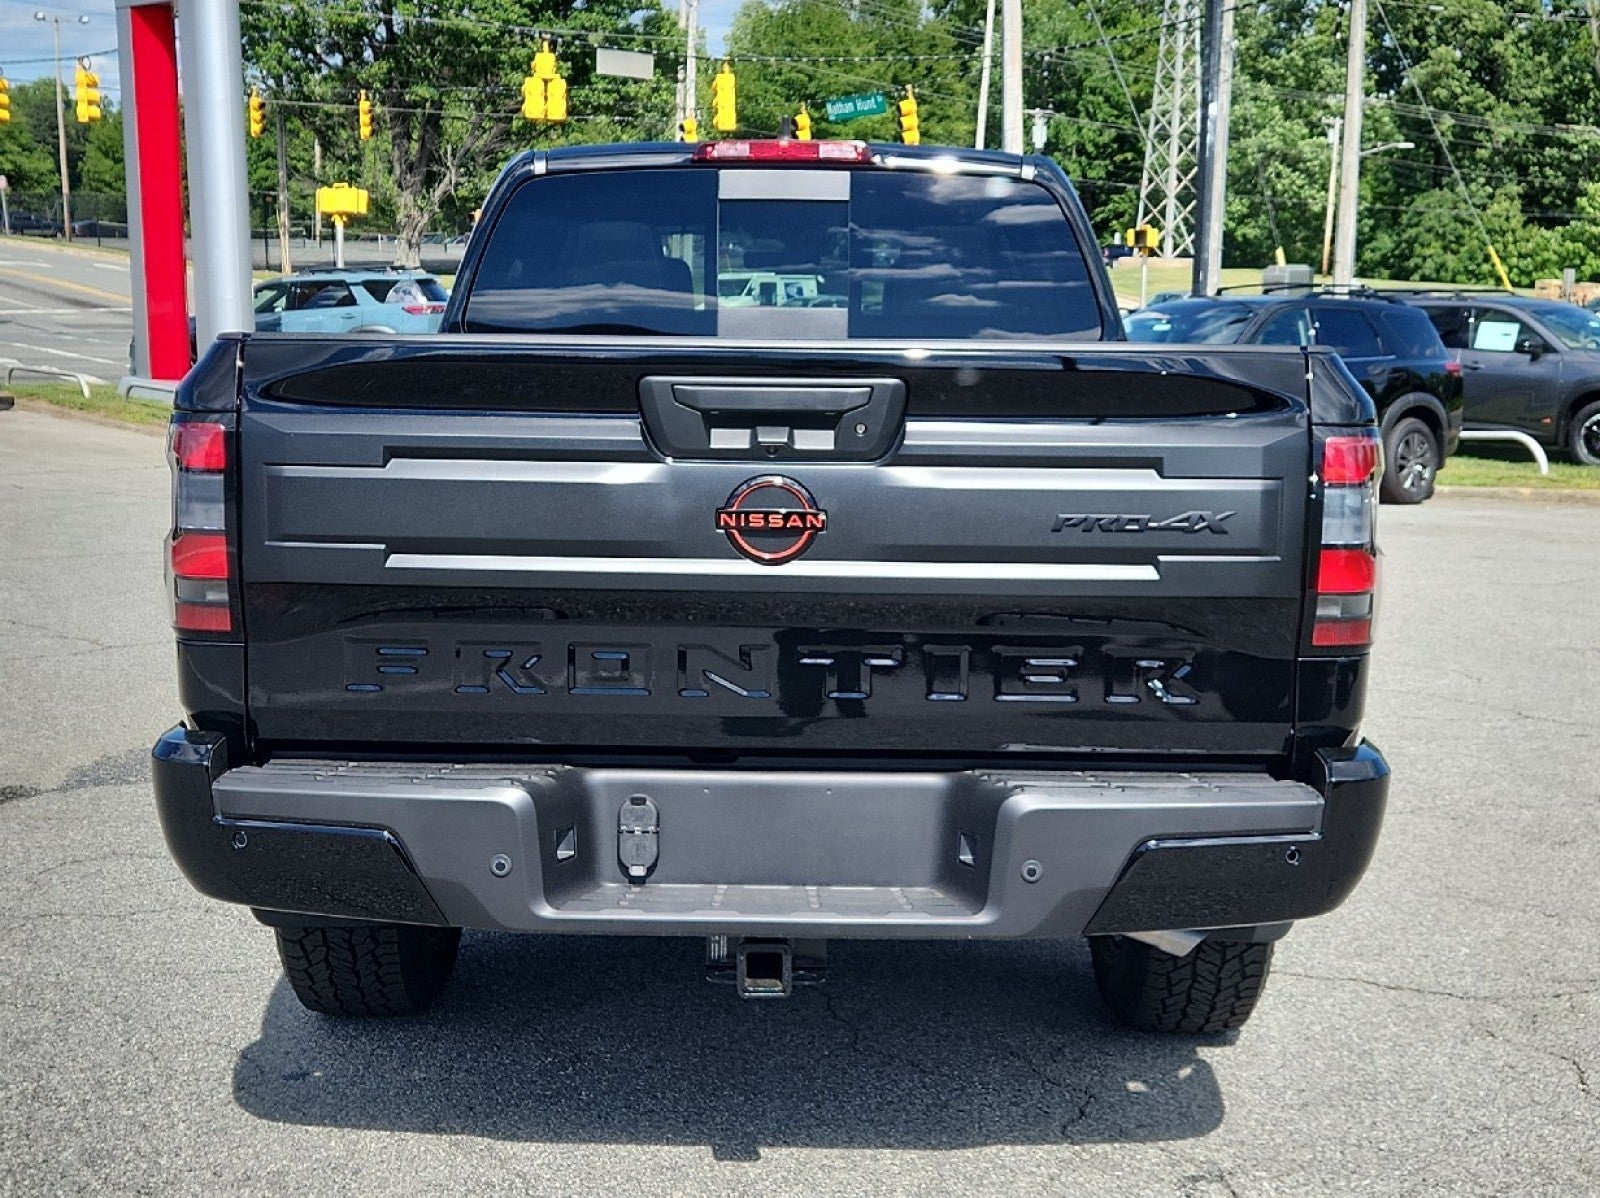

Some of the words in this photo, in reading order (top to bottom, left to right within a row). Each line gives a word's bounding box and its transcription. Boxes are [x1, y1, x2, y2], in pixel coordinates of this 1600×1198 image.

[720, 513, 824, 528] NISSAN
[1050, 510, 1238, 535] PRO-4X
[344, 635, 1200, 706] FRONTIER
